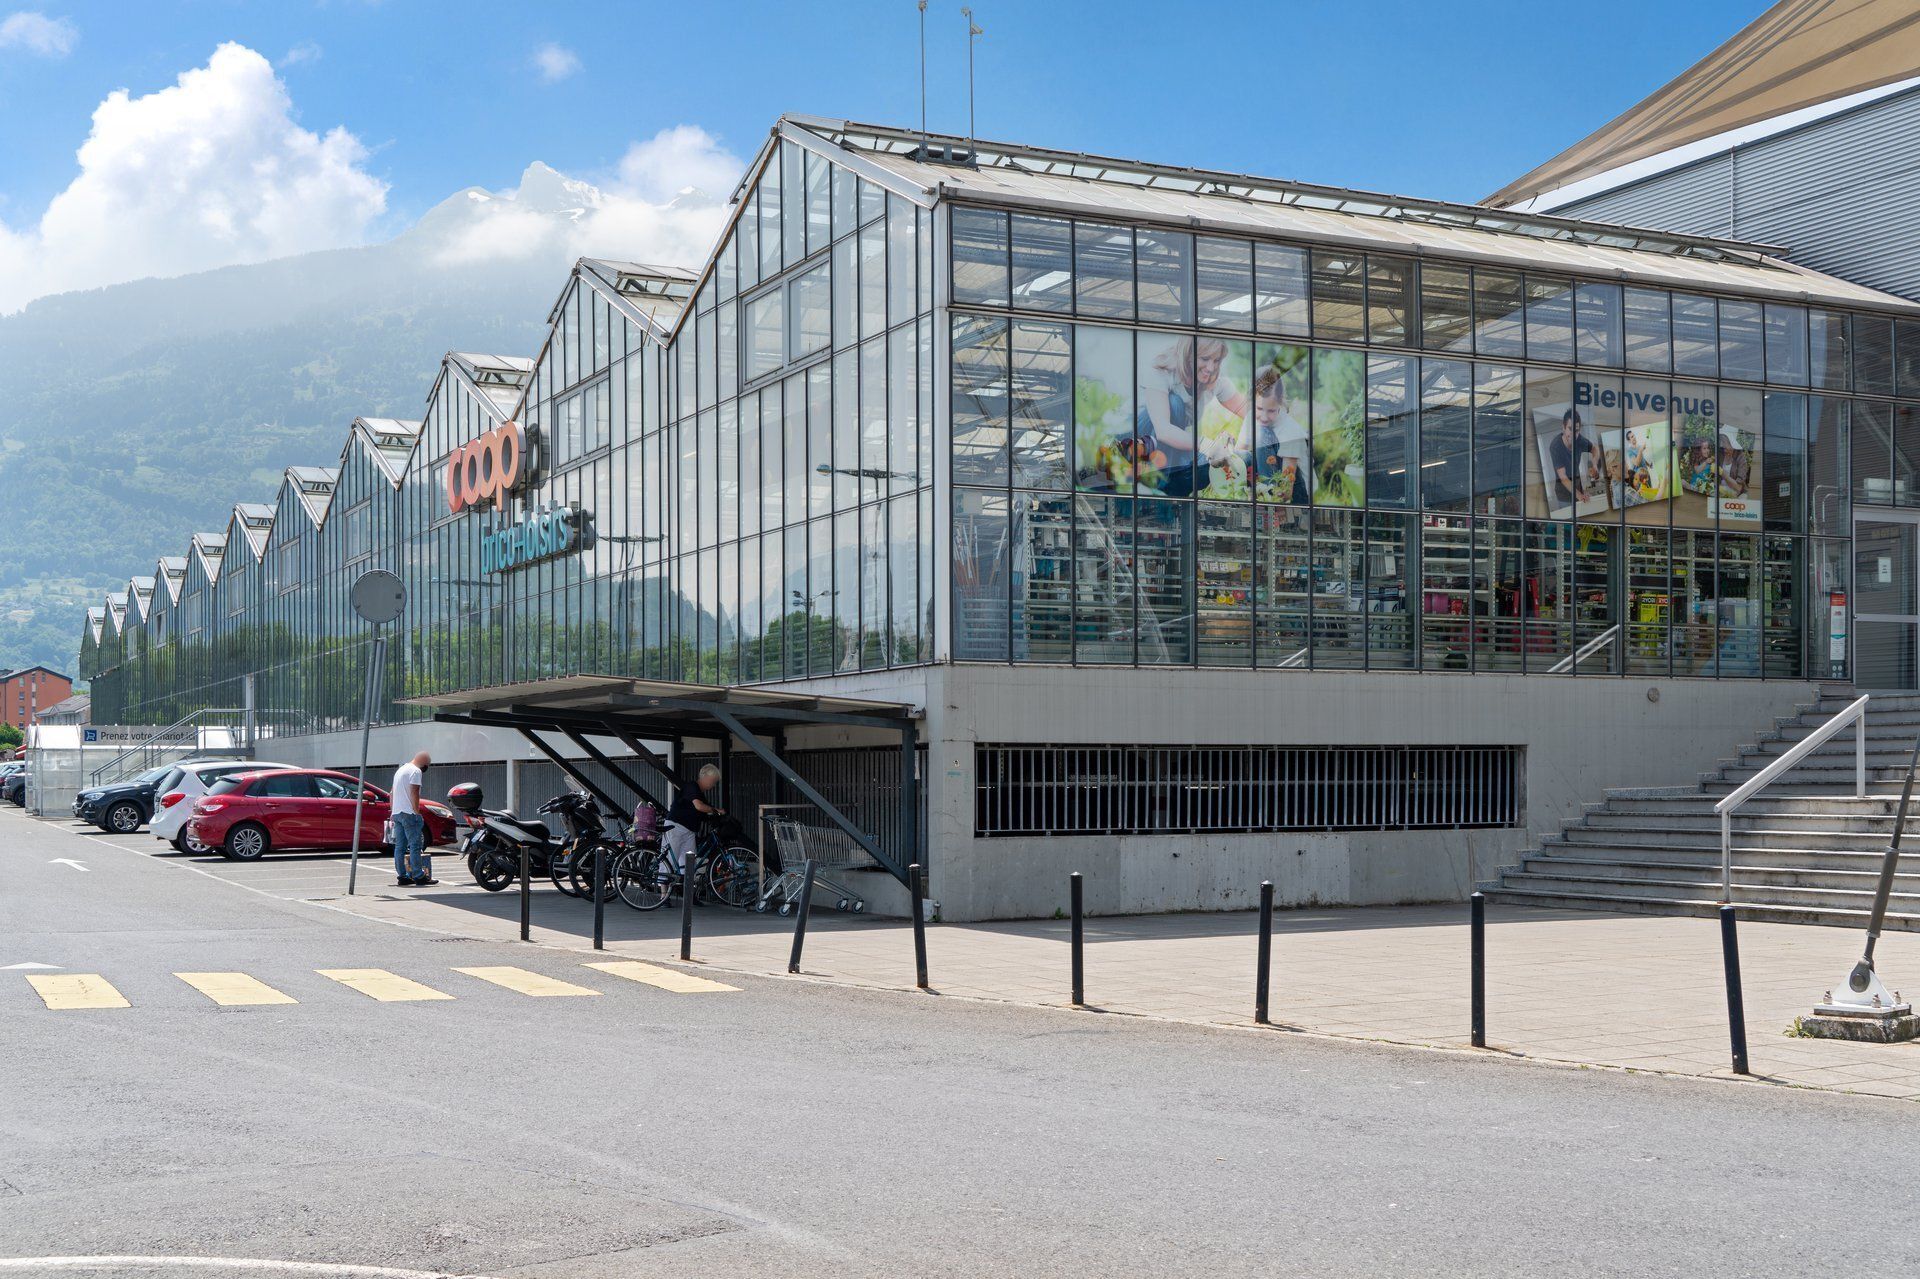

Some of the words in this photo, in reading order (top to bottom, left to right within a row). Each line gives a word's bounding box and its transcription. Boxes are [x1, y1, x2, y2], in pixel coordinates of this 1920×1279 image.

[1575, 382, 1715, 417] Bienvenue
[447, 421, 520, 512] coop
[1725, 502, 1745, 512] coop
[101, 731, 128, 740] Prenez
[131, 732, 152, 740] votre
